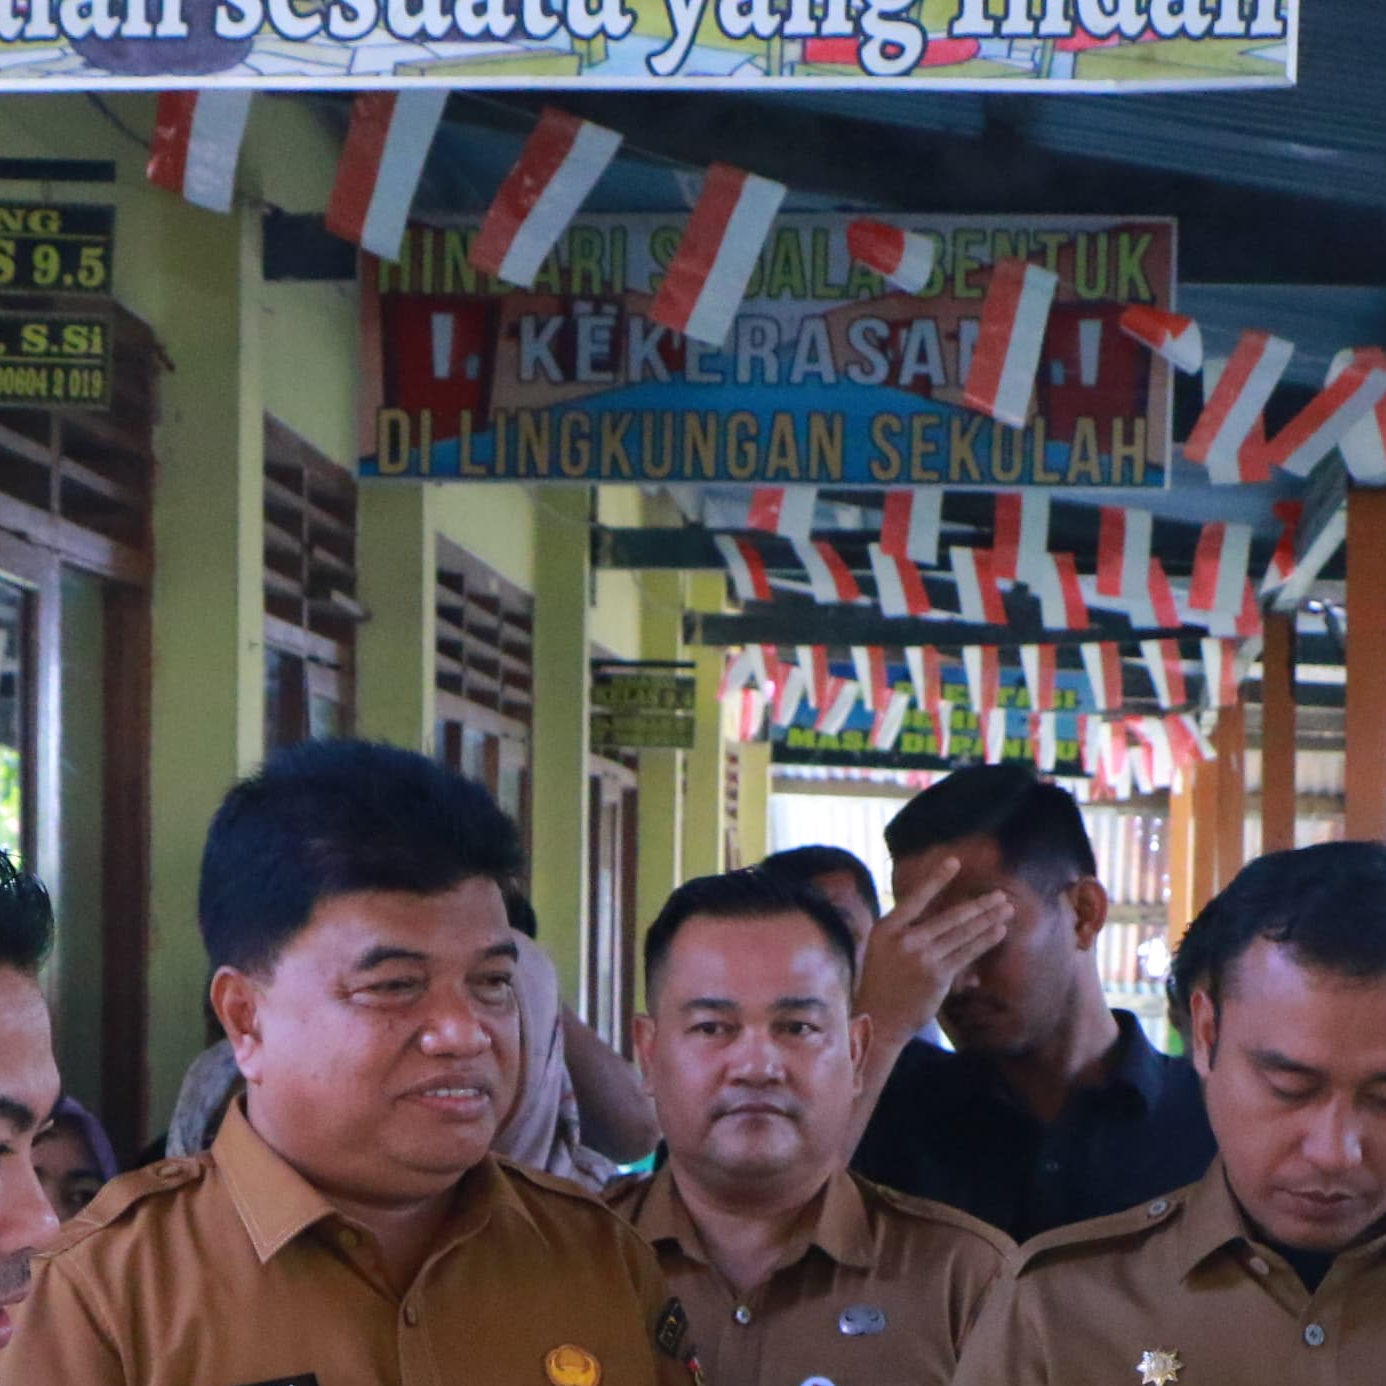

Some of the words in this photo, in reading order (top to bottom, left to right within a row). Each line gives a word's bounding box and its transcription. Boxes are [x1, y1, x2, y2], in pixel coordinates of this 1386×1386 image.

[32, 244, 106, 288] 9.5
[378, 225, 629, 295] HINARI
[649, 226, 886, 300] SALA
[21, 323, 104, 354] S.Si
[53, 367, 65, 398] 2
[377, 406, 434, 476] DI
[459, 408, 845, 482] LINGKUNGAN
[869, 413, 1148, 485] SEKOLAH
